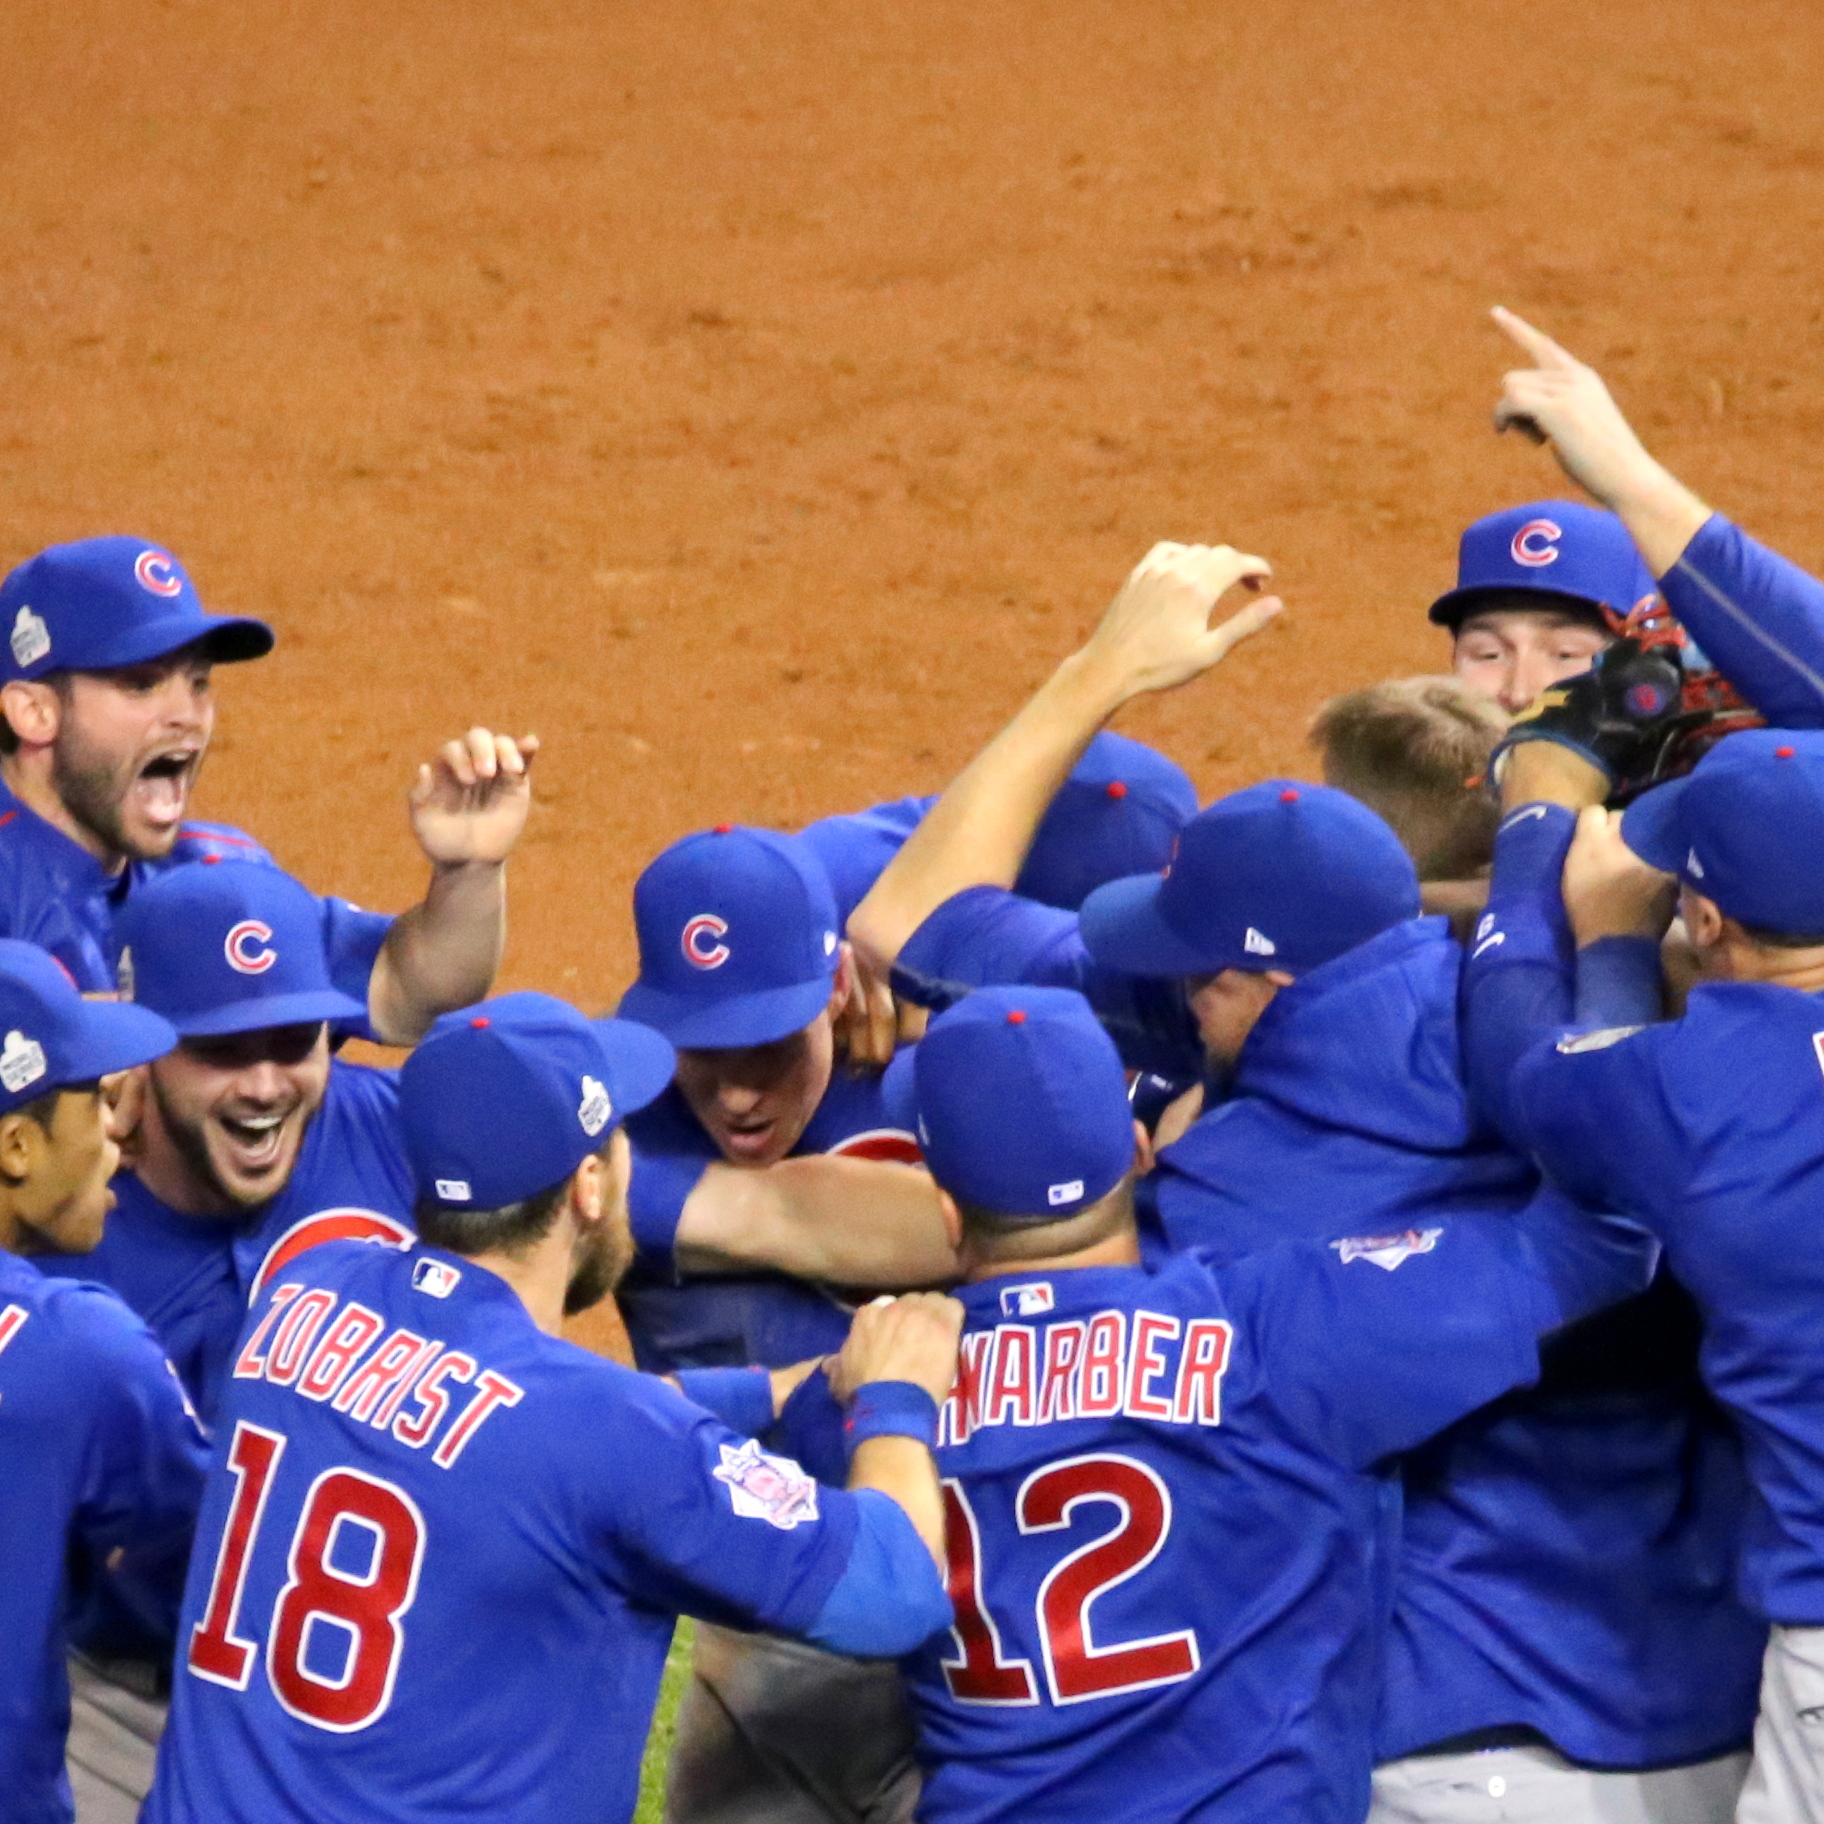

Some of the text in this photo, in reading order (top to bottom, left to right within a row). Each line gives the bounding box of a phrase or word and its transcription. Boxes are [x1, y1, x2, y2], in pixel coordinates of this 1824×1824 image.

[1511, 518, 1563, 567] C
[134, 549, 181, 597] C
[224, 919, 277, 975] C
[681, 913, 730, 970] C
[232, 1283, 526, 1470] ZOBRIST
[187, 1418, 427, 1734] 18
[939, 1452, 1201, 1707] 12
